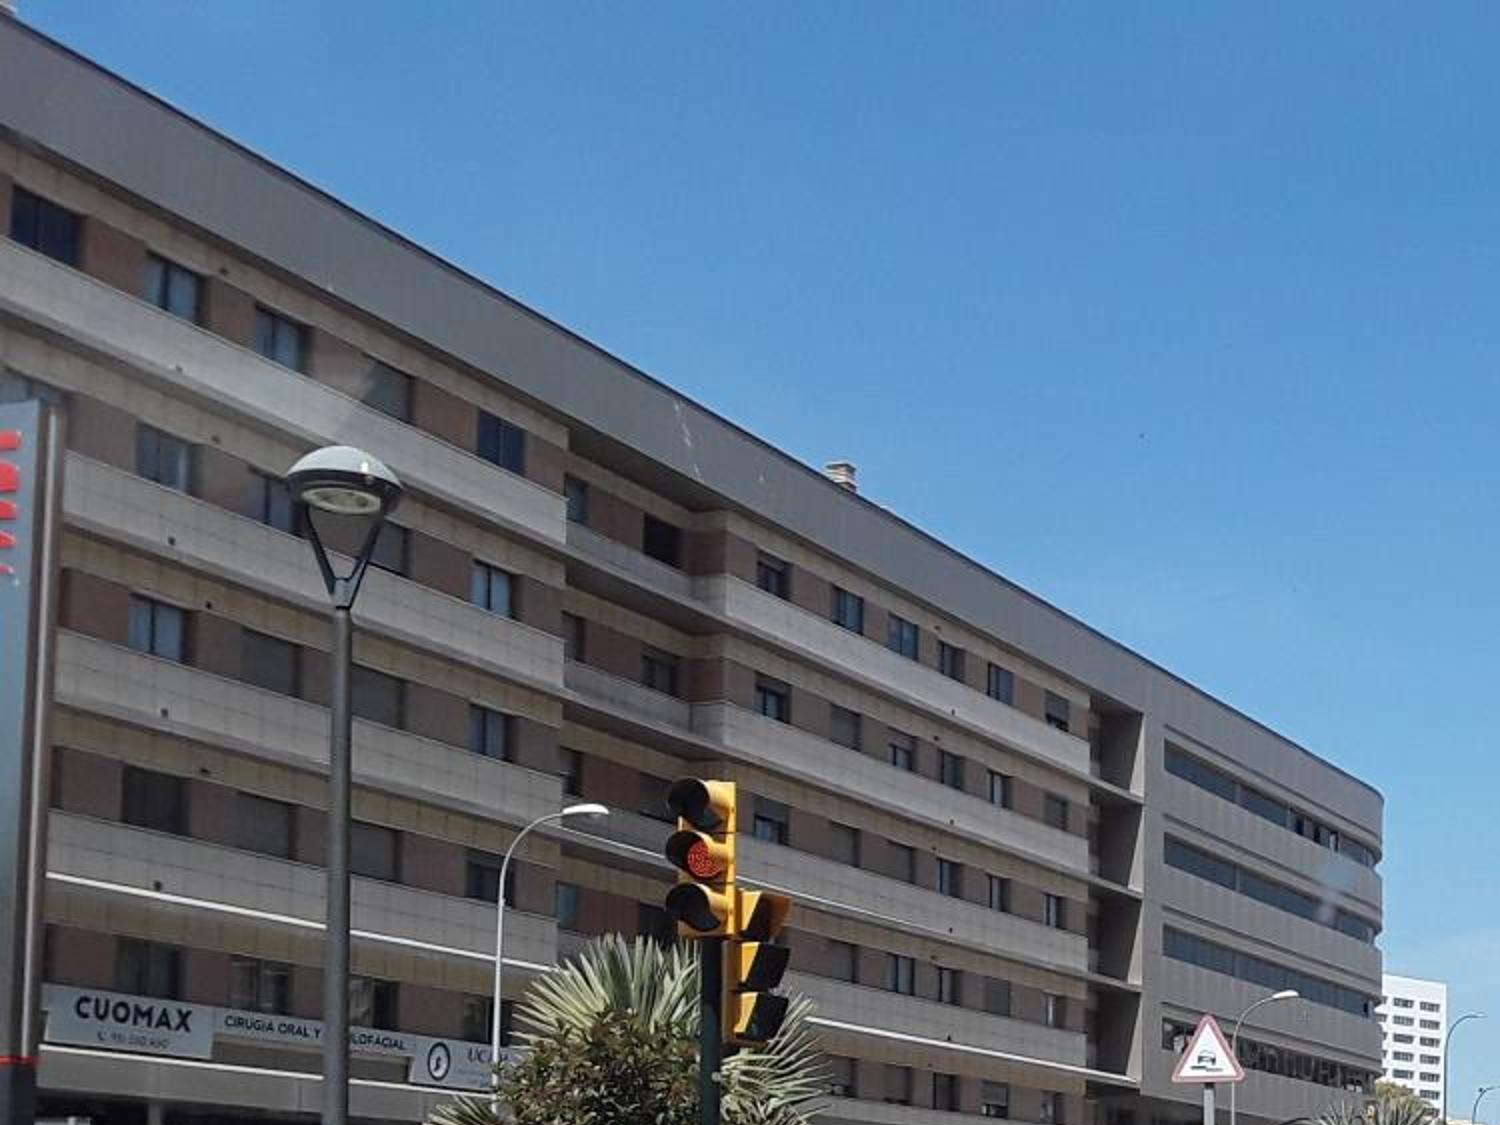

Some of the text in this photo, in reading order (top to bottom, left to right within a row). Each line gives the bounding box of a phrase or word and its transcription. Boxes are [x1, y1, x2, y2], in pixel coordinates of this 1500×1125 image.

[75, 995, 192, 1033] CUOMAX
[278, 1022, 310, 1038] ORAL
[313, 1027, 320, 1039] Y
